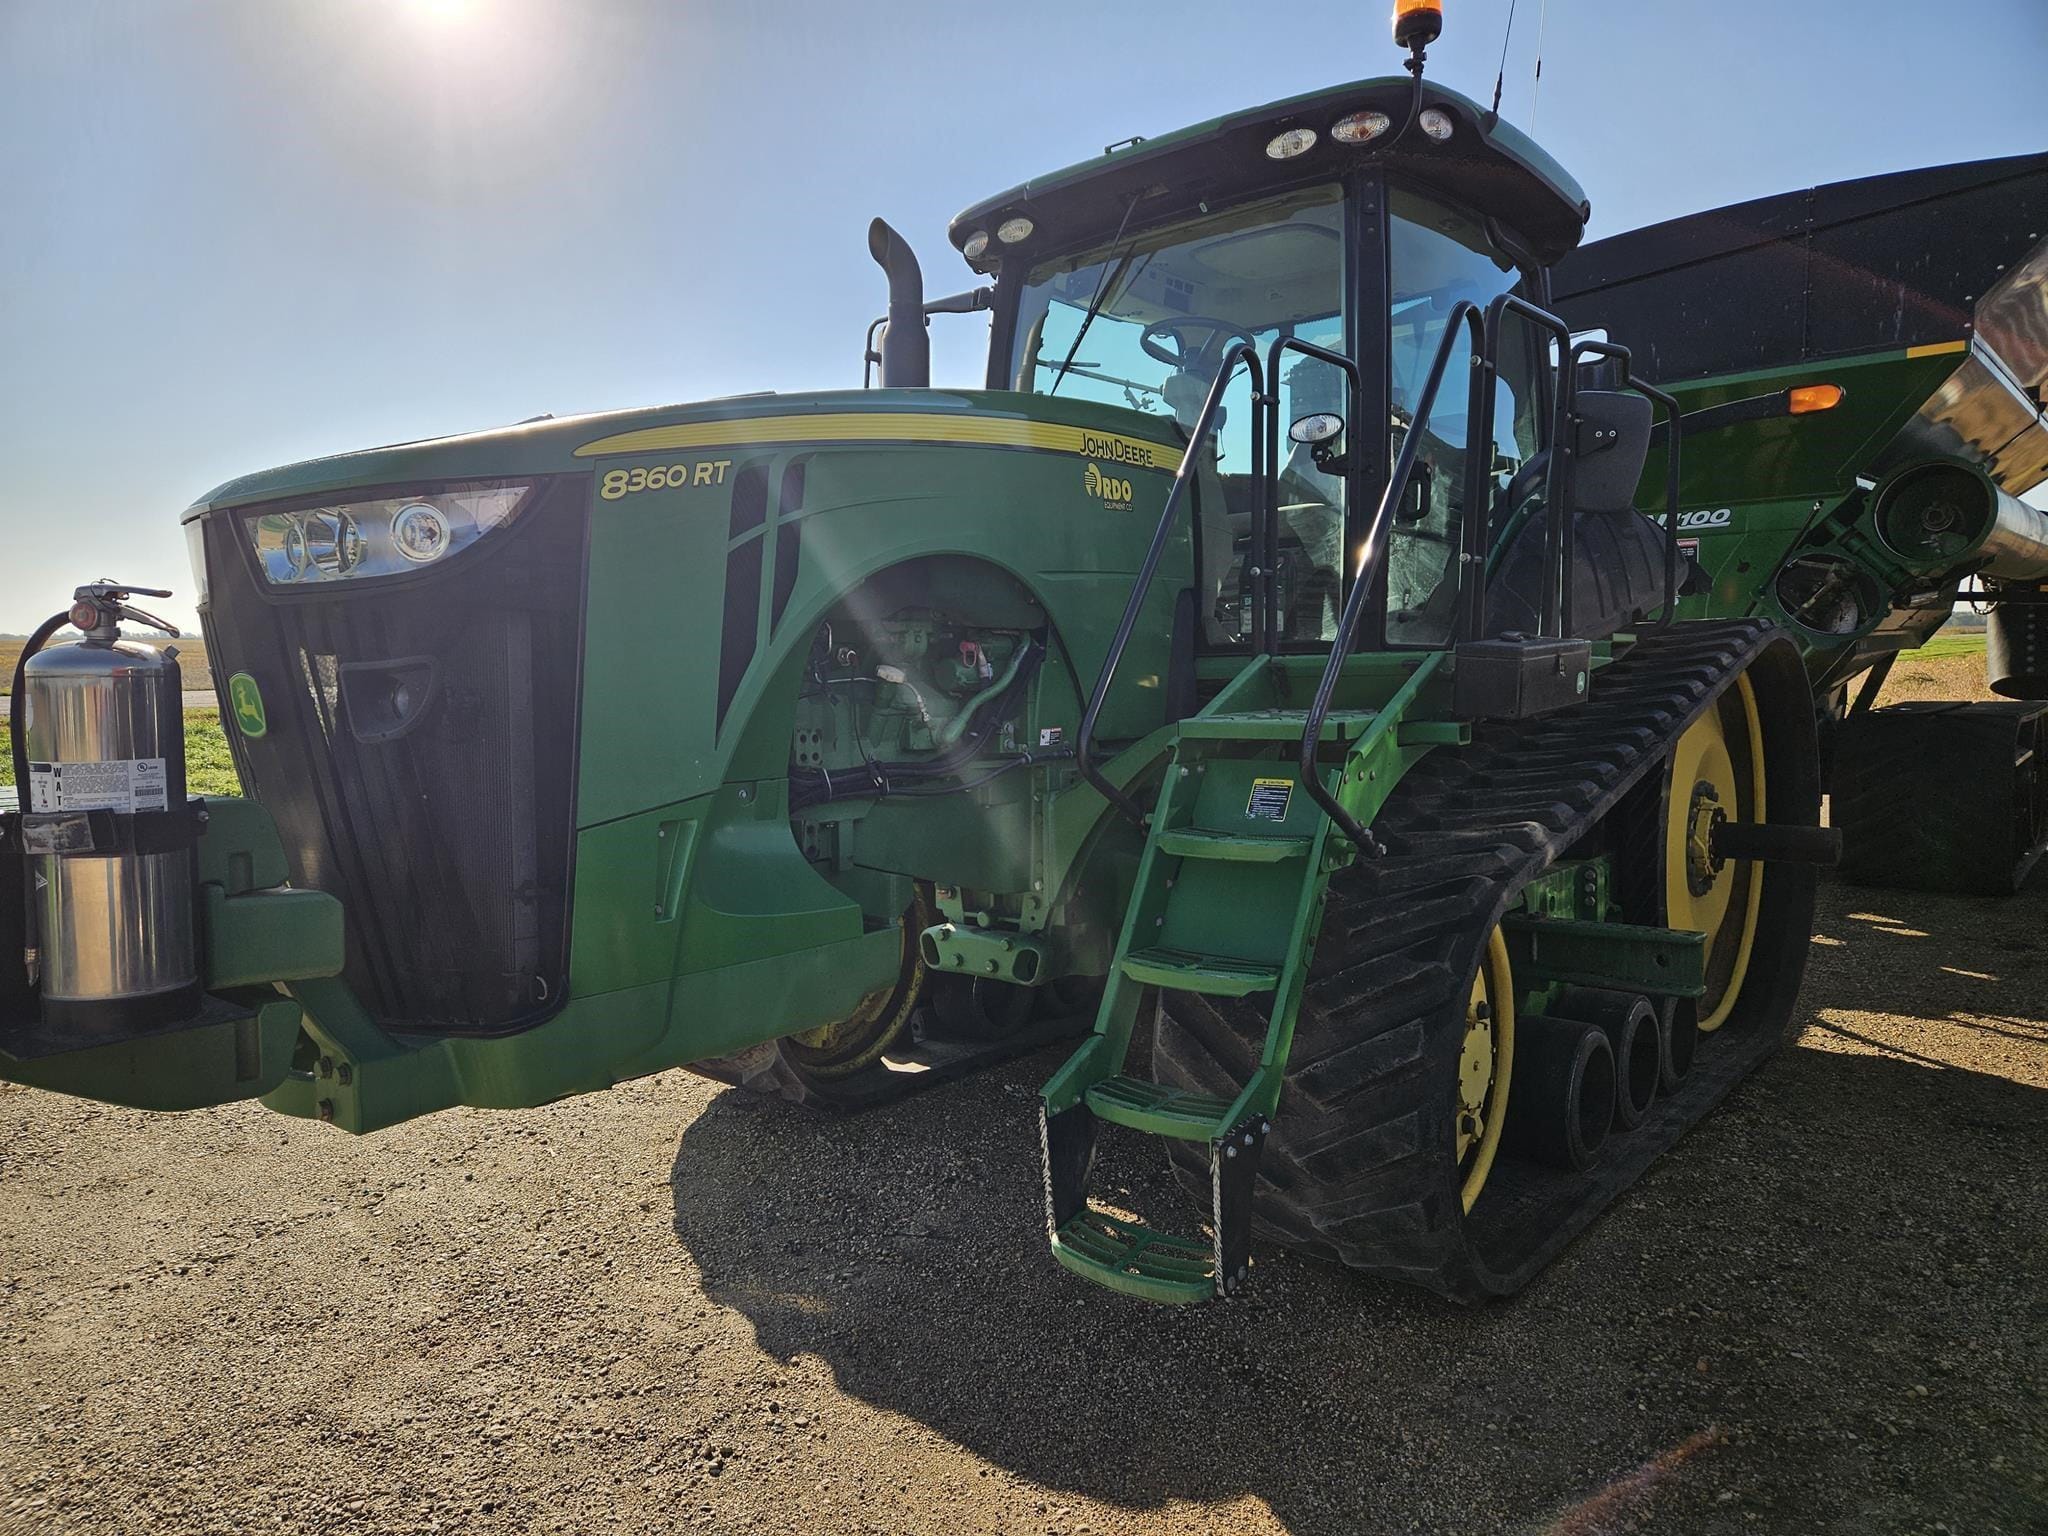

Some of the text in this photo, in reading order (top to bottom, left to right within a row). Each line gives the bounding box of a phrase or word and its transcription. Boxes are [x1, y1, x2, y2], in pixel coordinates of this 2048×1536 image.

[600, 460, 731, 500] 8360 RT
[1102, 477, 1132, 502] RDO
[53, 767, 62, 812] WAT
